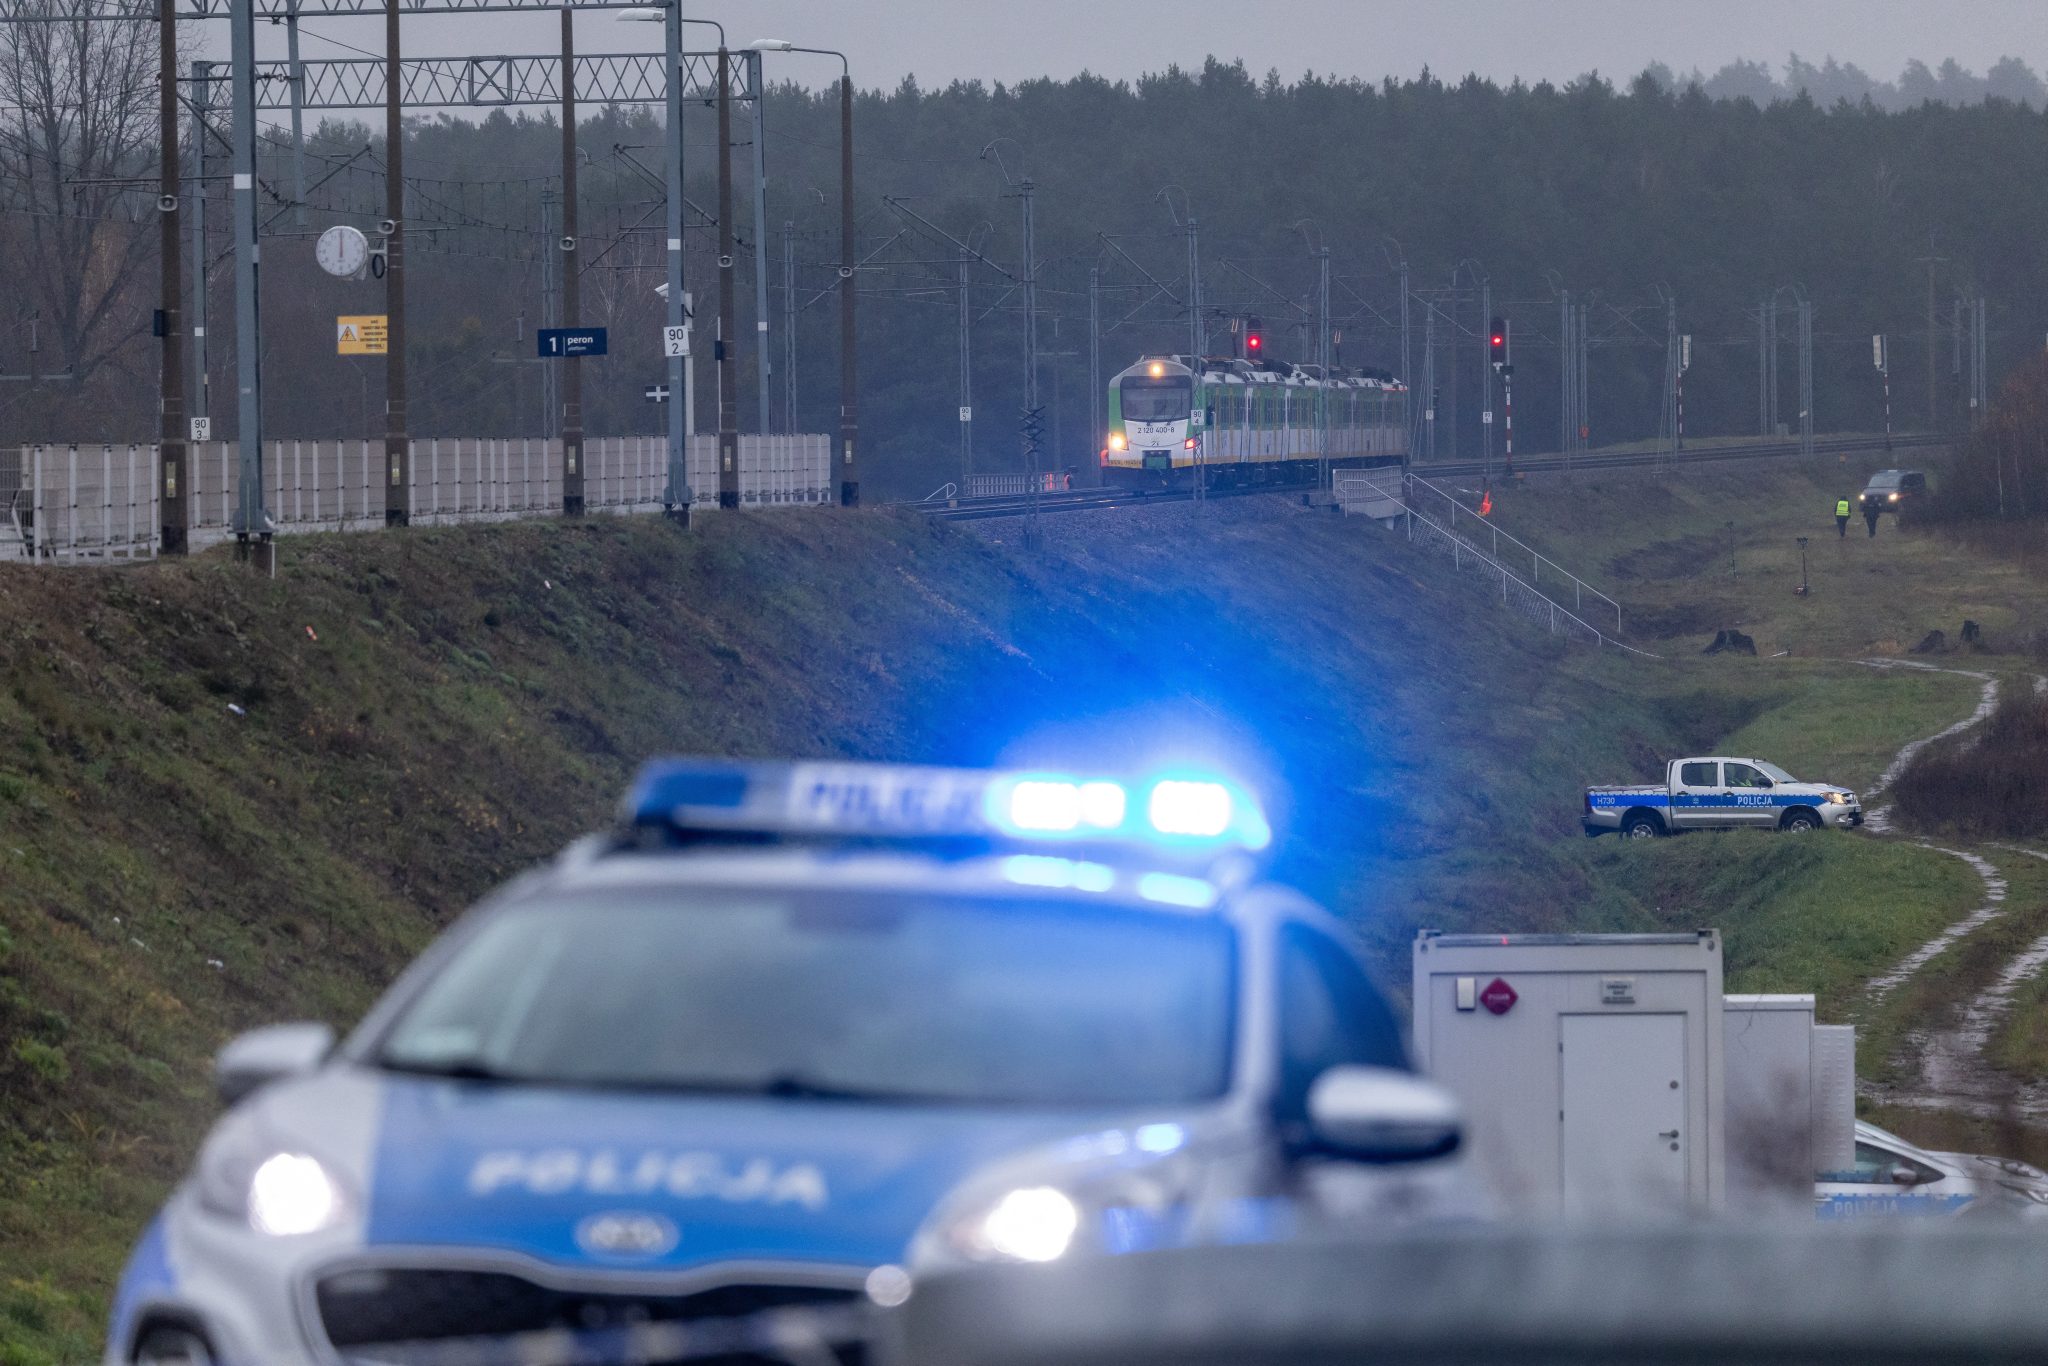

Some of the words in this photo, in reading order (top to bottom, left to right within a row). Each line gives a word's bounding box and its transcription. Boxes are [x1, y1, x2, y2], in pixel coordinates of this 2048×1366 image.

[668, 328, 684, 341] 90
[549, 336, 557, 353] 1
[567, 336, 593, 346] peron
[671, 342, 680, 355] 2
[1193, 410, 1202, 418] 90
[194, 419, 207, 429] 90
[196, 429, 203, 440] 3
[1596, 797, 1616, 805] H730
[1737, 796, 1773, 805] POLICJA
[472, 1151, 826, 1208] POLICJA
[1834, 1199, 1899, 1216] POLICJA
